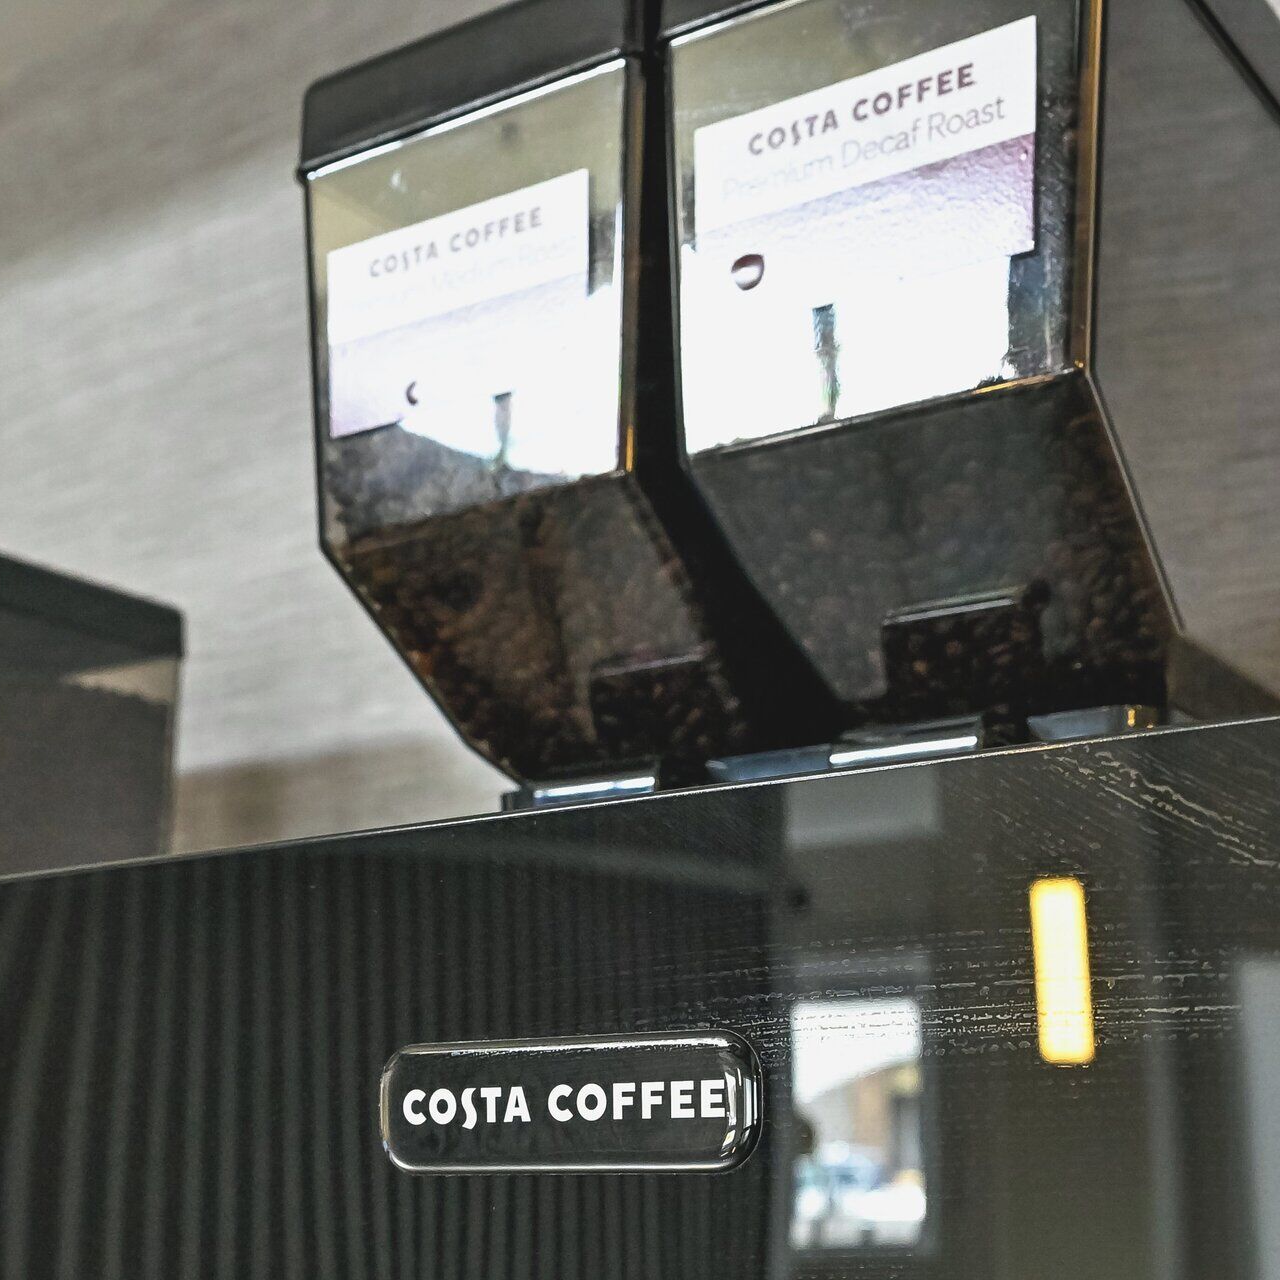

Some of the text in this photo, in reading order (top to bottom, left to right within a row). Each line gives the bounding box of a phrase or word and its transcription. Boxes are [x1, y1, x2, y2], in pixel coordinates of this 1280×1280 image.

[746, 61, 978, 157] COSTA COFFEE
[841, 117, 923, 169] Decaf
[927, 96, 1007, 143] Roast
[368, 240, 439, 279] COSTA
[448, 206, 543, 254] COFFEE
[402, 1078, 726, 1130] COSTA COFFEE
